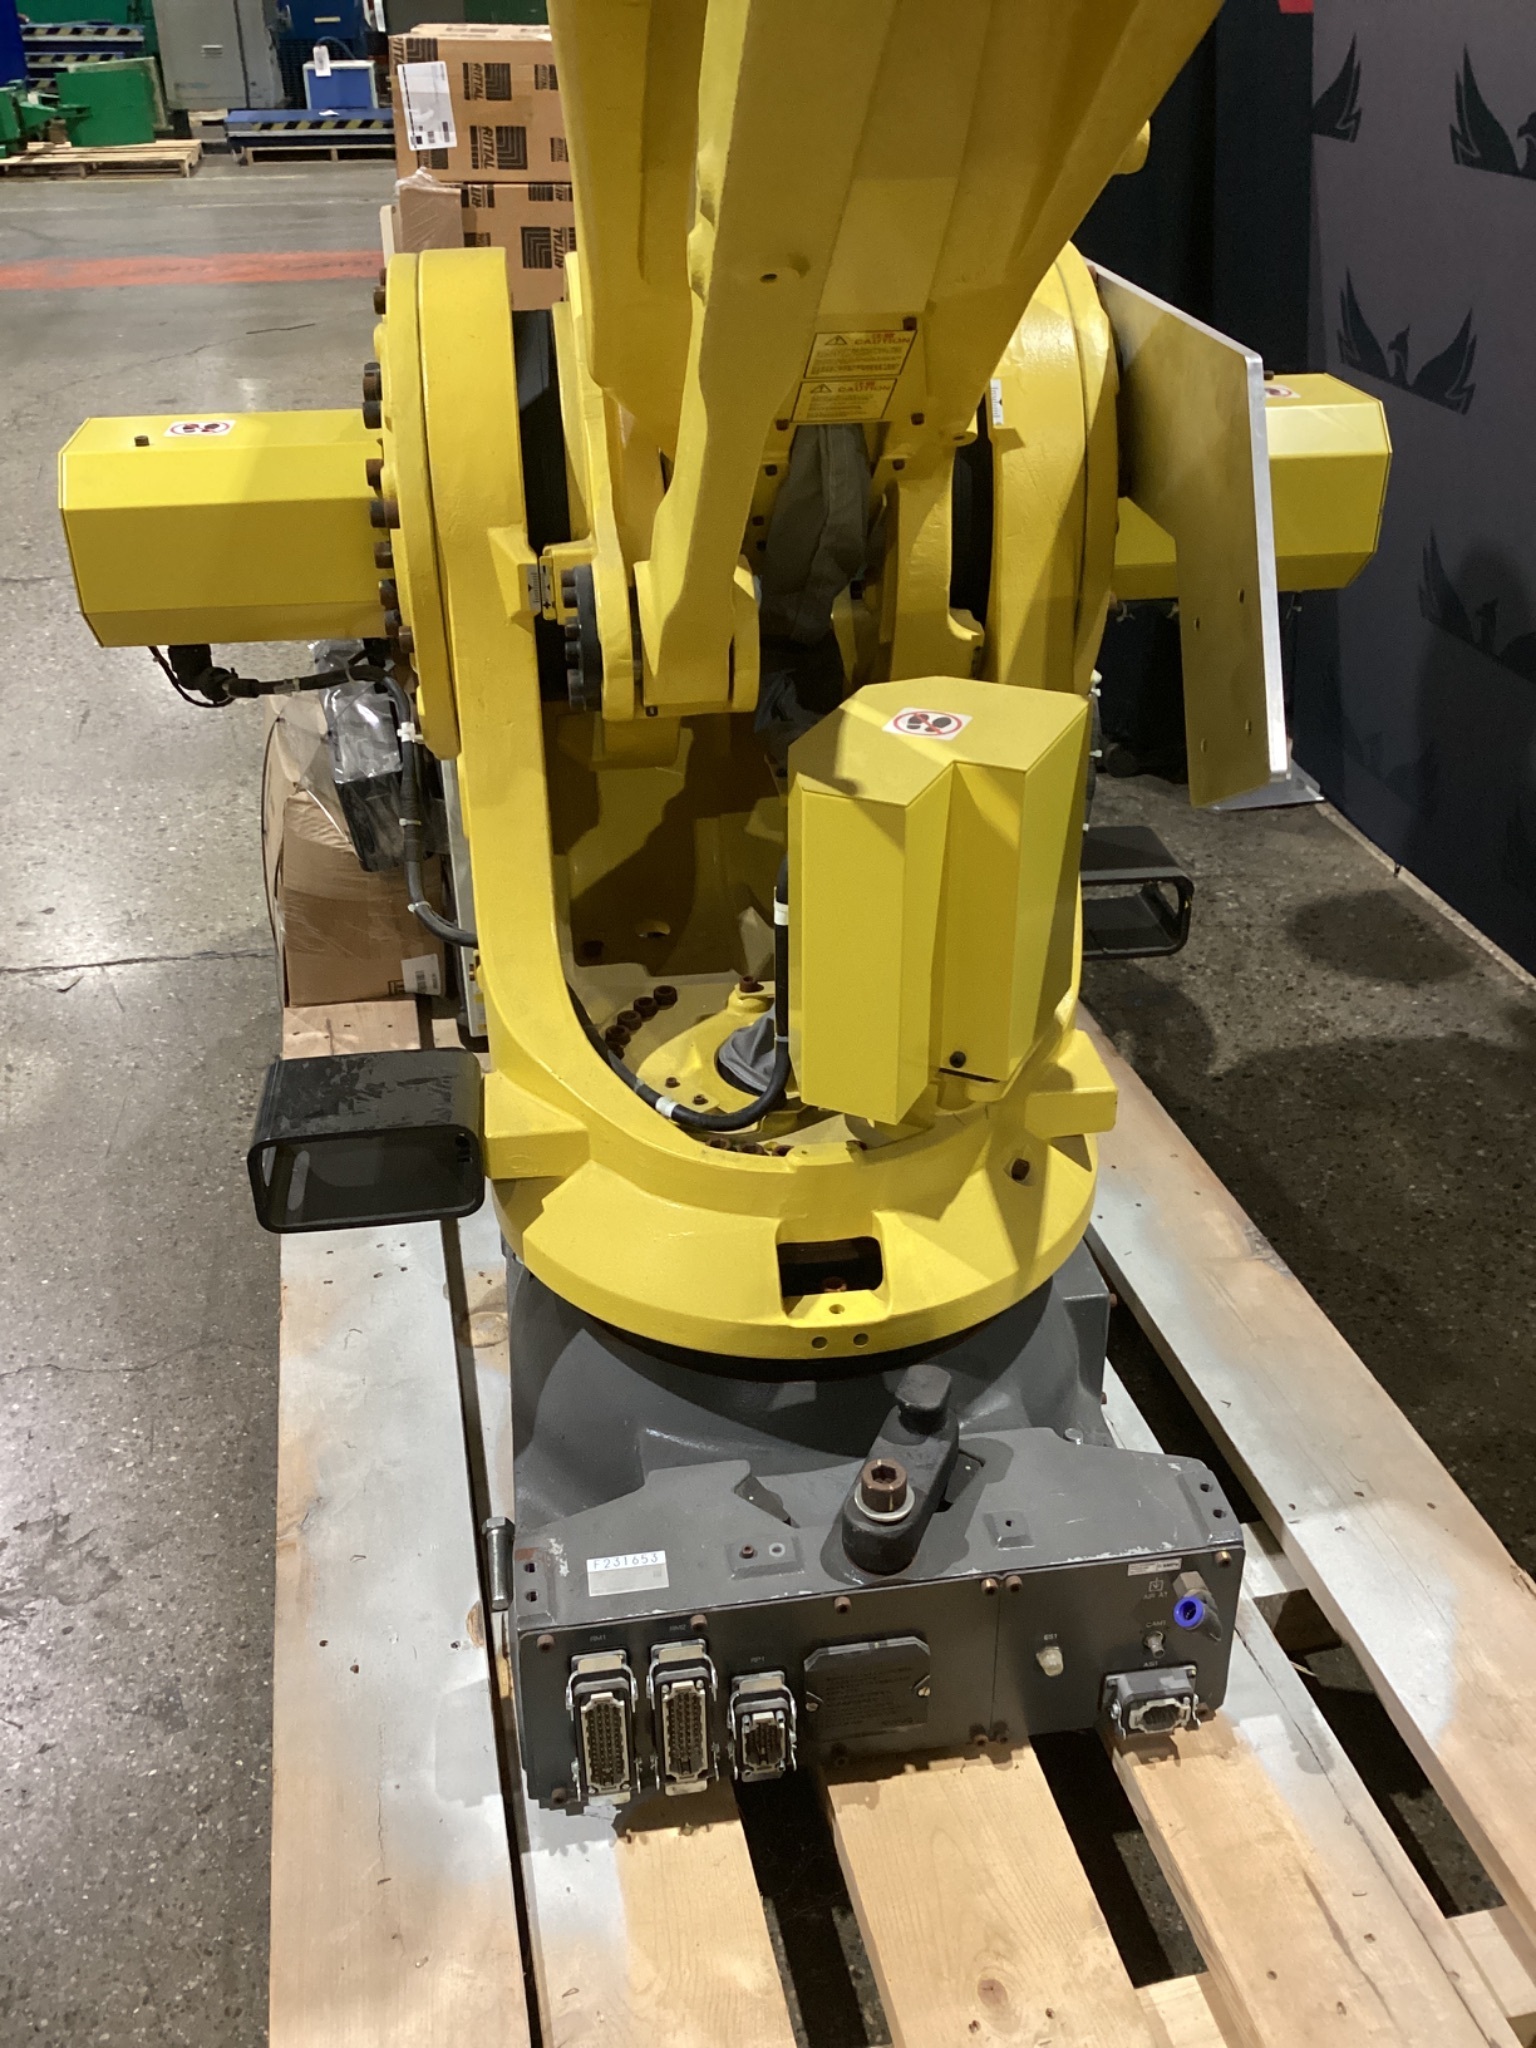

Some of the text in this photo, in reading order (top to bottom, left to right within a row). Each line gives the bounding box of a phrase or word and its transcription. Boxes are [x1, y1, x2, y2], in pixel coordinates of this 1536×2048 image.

[473, 63, 485, 100] RITTAL
[483, 126, 496, 170] RITTAL
[553, 228, 565, 269] RITTAL
[854, 337, 911, 346] CAUTION
[838, 384, 892, 393] CAUTION
[593, 1553, 660, 1570] F231653
